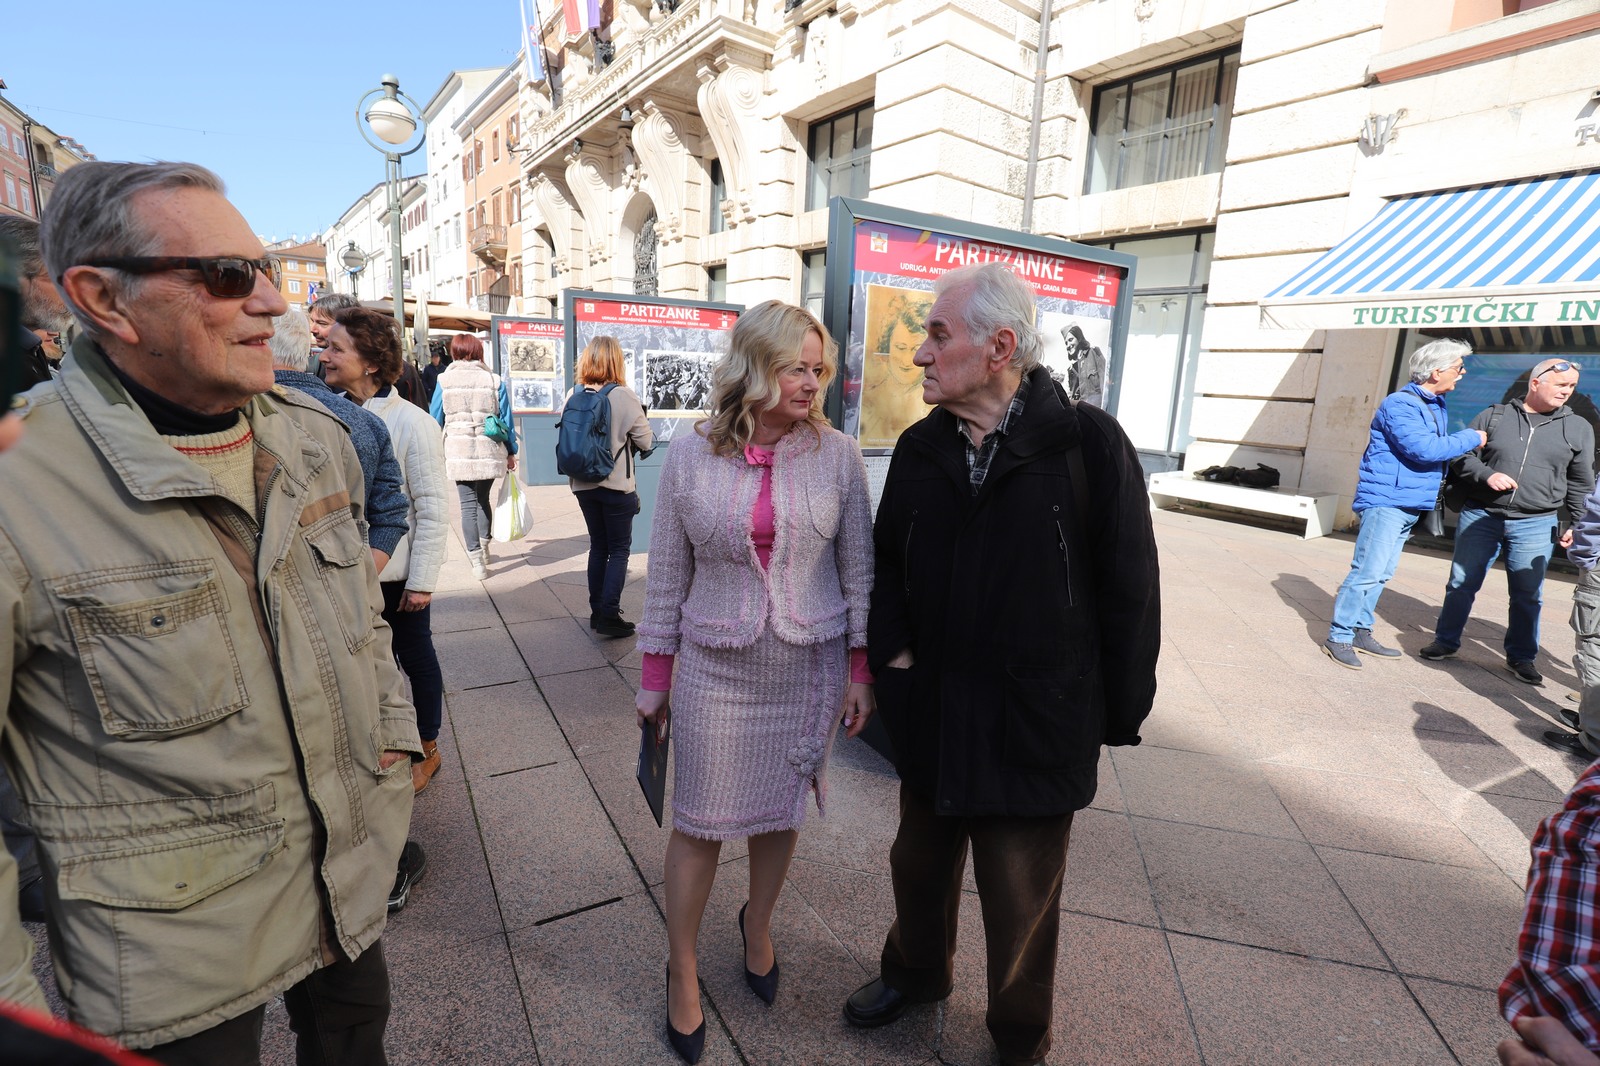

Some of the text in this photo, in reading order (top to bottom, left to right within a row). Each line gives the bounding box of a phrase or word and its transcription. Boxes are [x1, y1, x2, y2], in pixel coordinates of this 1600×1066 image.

[900, 262, 927, 273] UDRUGA
[1042, 283, 1060, 293] GRADA
[1353, 297, 1538, 325] TURISTIČKI
